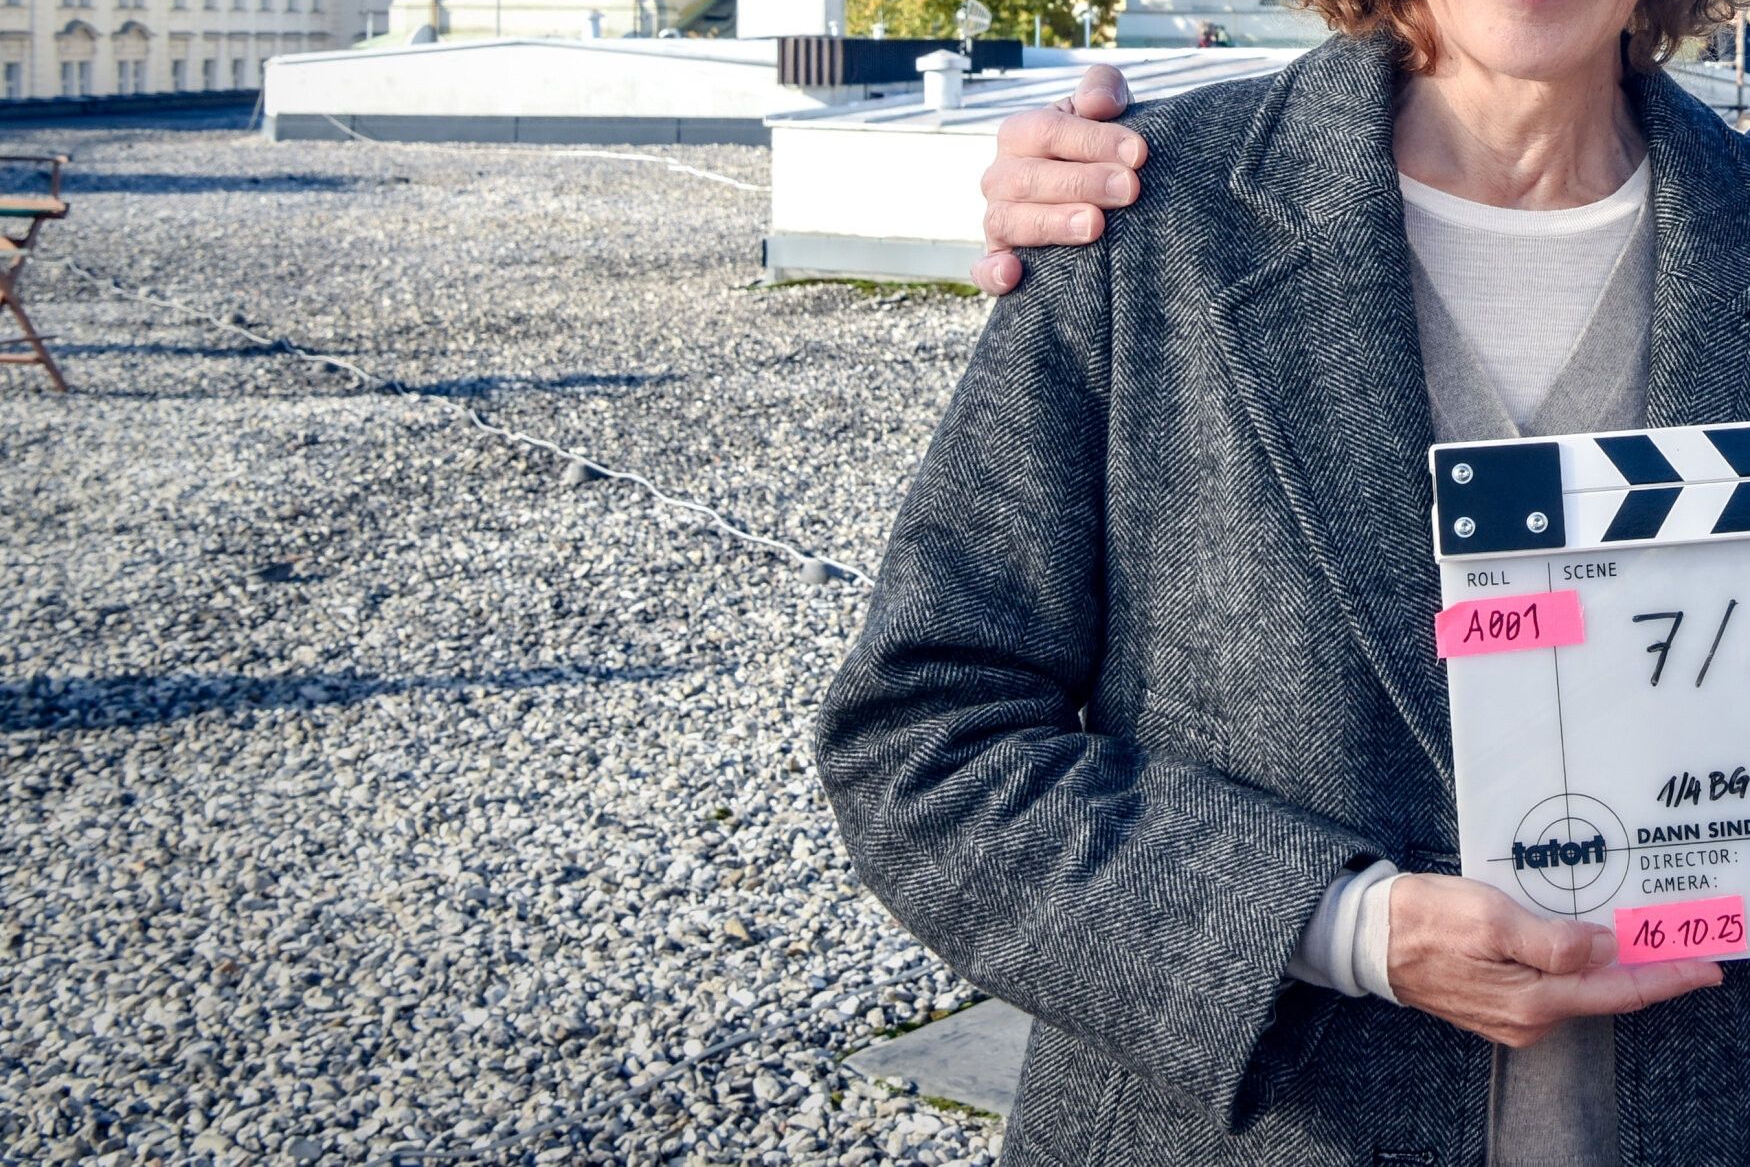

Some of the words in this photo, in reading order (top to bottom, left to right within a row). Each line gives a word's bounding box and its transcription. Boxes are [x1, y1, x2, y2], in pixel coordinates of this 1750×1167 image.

[1466, 571, 1511, 587] ROLL
[1563, 562, 1618, 581] SCENE
[1709, 766, 1750, 801] BG
[1637, 823, 1701, 844] DANN
[1512, 835, 1606, 870] tatort
[1640, 848, 1739, 871] DIRECTOR:
[1641, 873, 1718, 895] CAMERA:
[1633, 914, 1743, 949] 16.10.25
